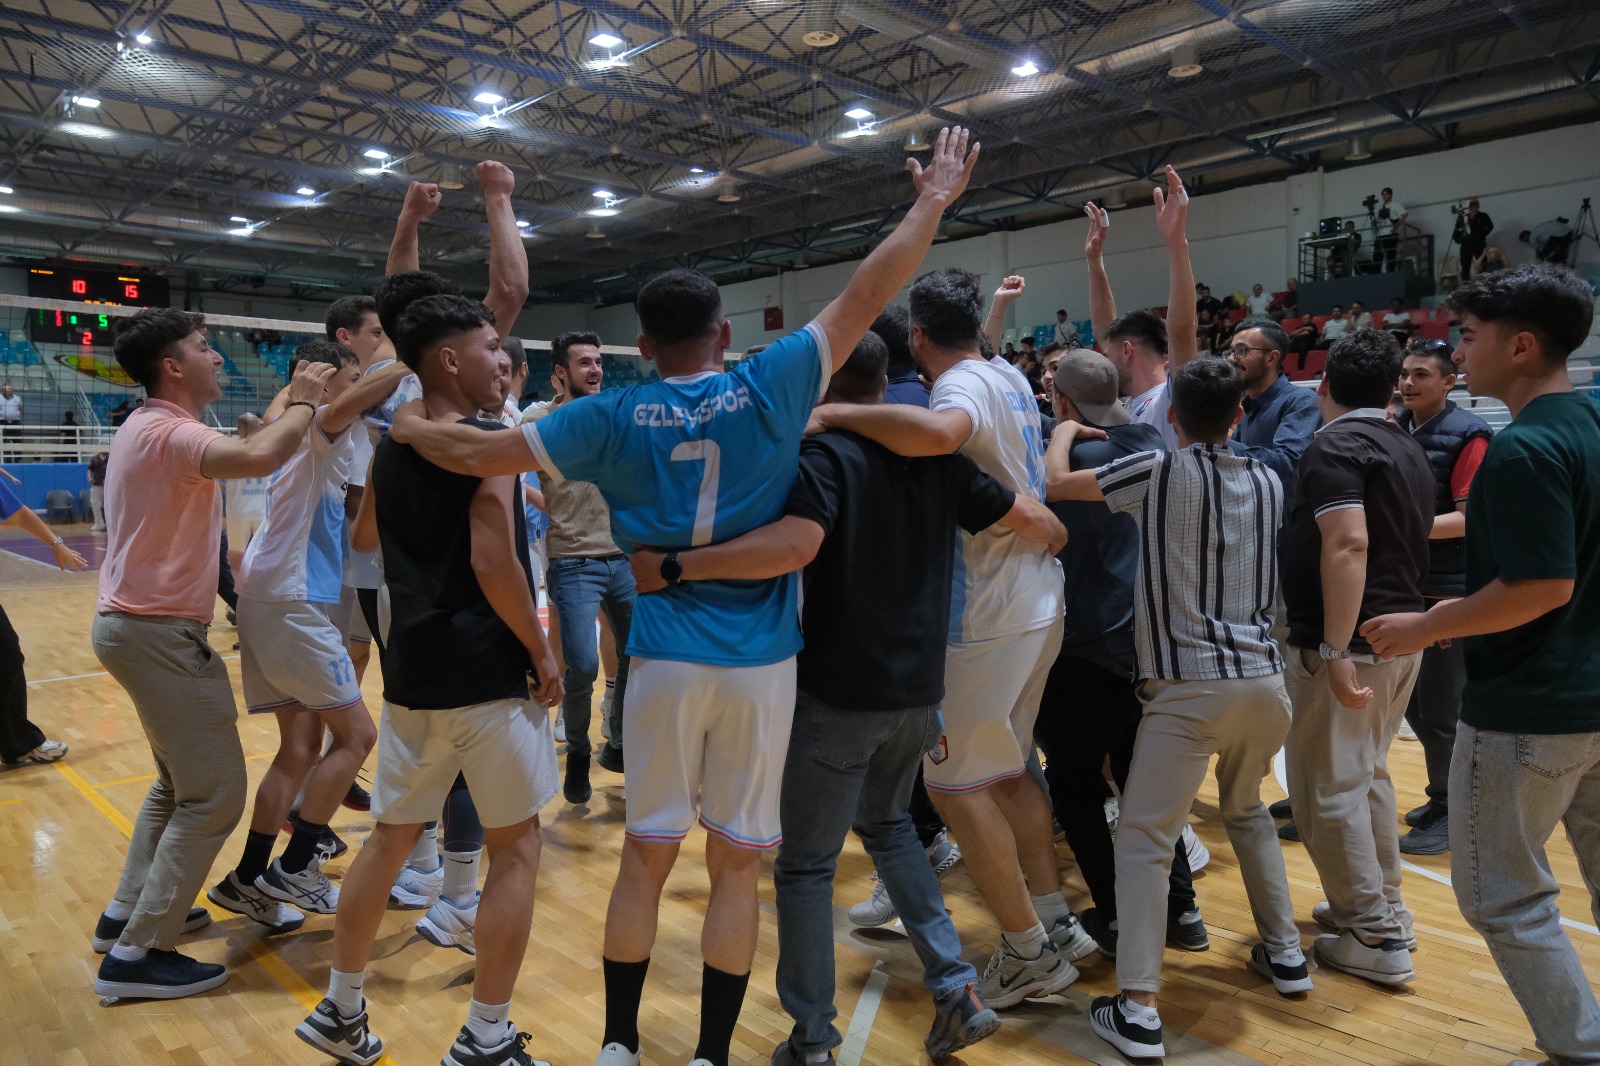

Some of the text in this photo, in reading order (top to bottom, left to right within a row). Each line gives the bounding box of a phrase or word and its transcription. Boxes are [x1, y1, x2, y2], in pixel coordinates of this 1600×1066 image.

[72, 280, 86, 294] 10
[125, 285, 138, 298] 15
[82, 332, 93, 345] 2
[671, 438, 721, 547] 7
[328, 656, 351, 687] 17
